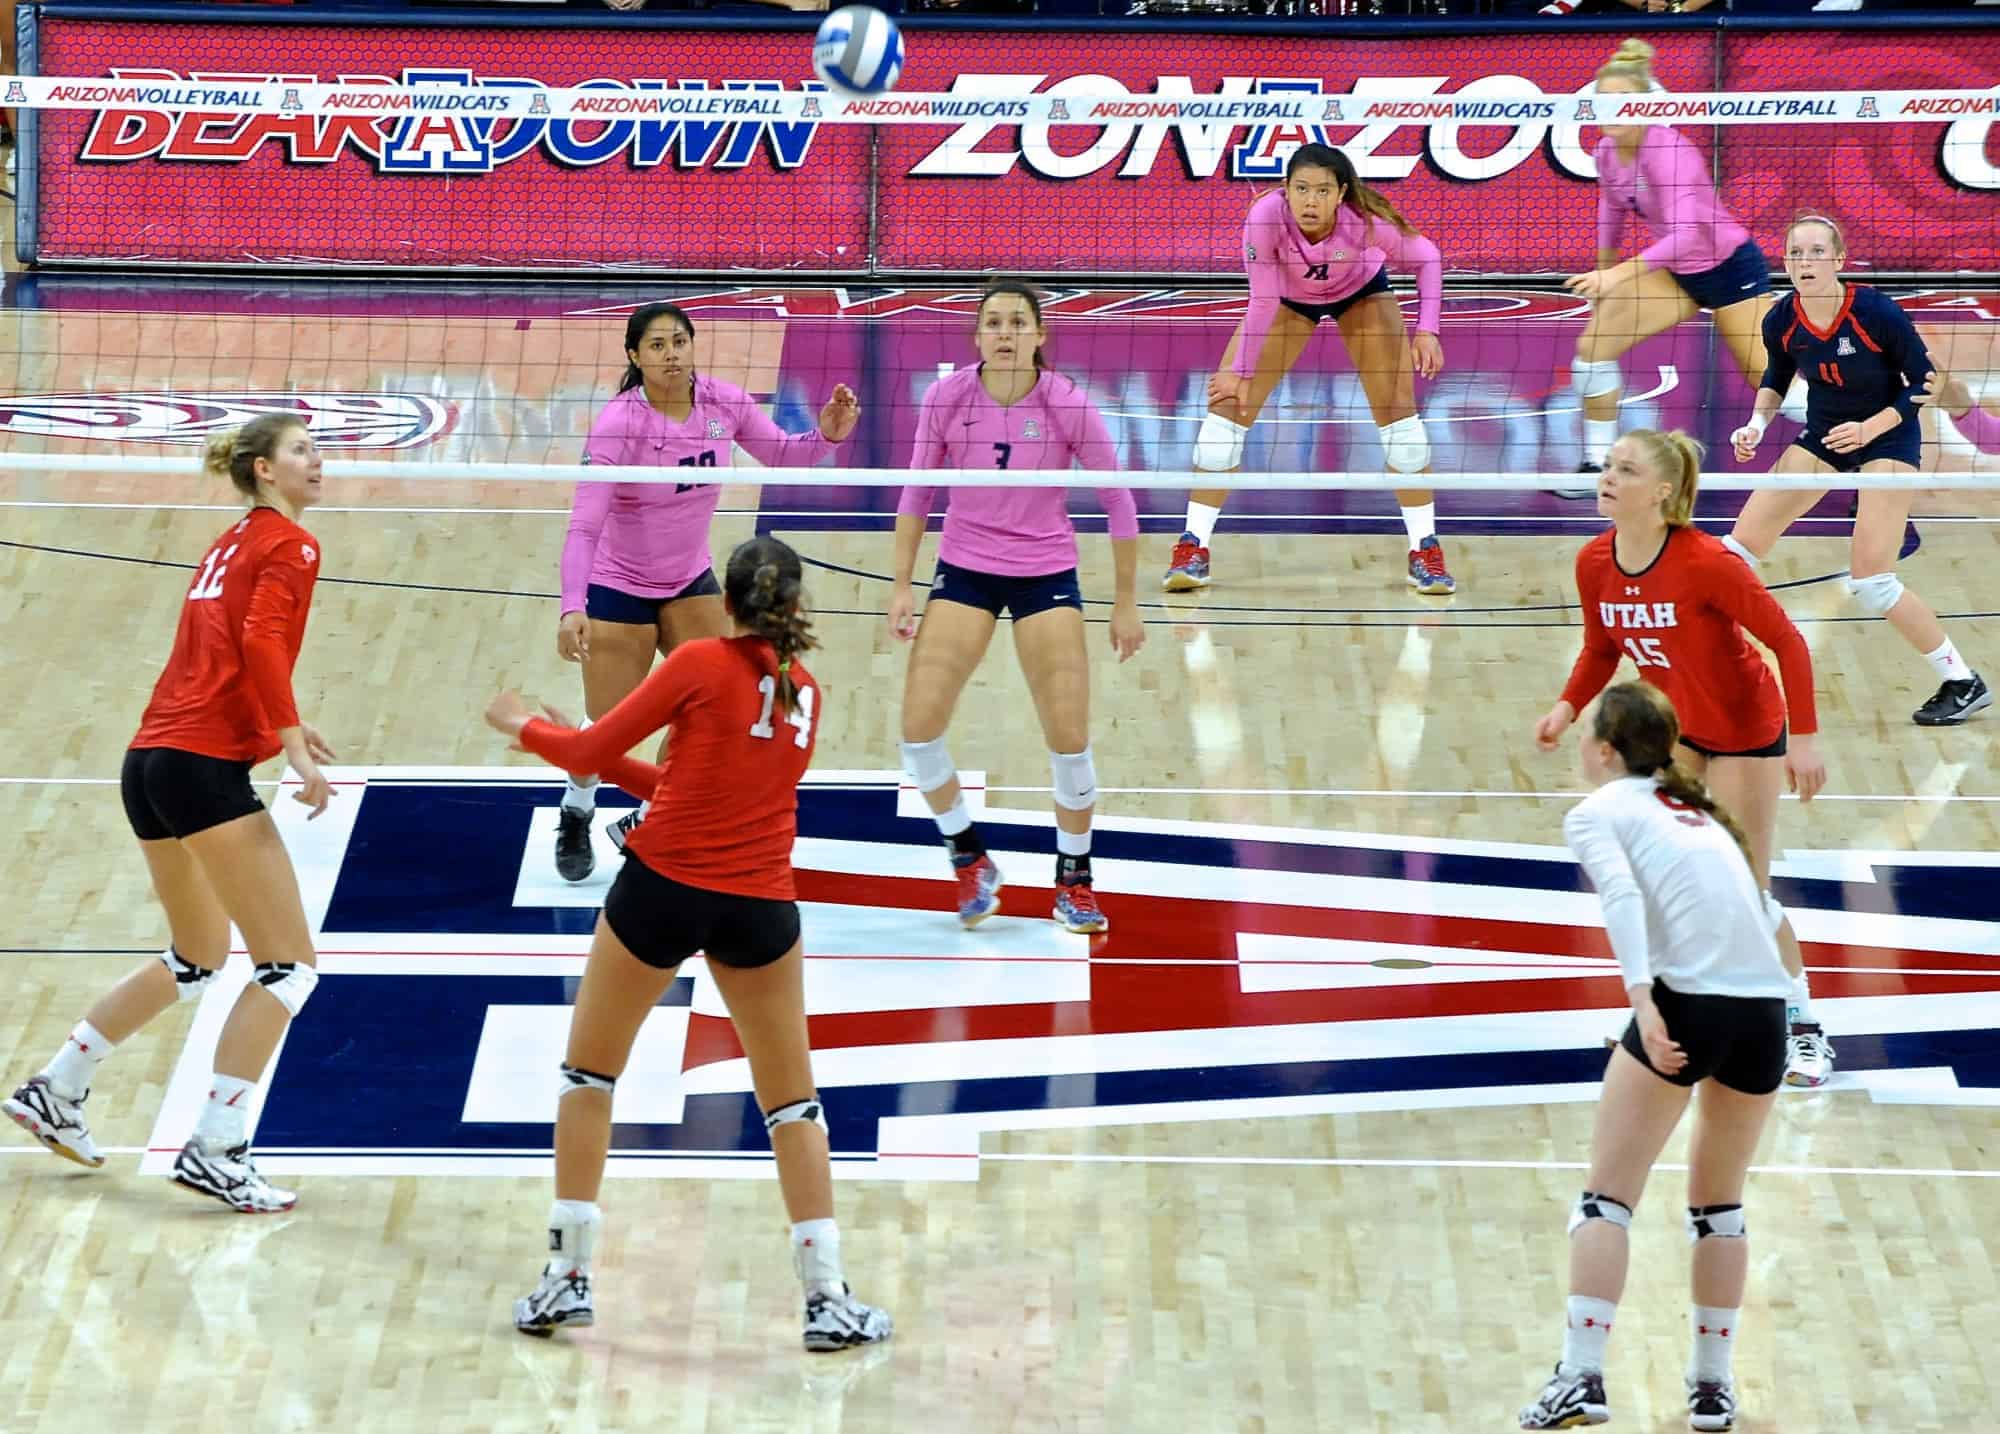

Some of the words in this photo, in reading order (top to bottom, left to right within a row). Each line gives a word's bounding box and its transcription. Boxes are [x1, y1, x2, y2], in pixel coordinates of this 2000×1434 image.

[1901, 97, 2000, 115] ARIZONA
[1599, 601, 1679, 629] UTAH
[1623, 637, 1672, 670] 15
[749, 673, 815, 751] 14
